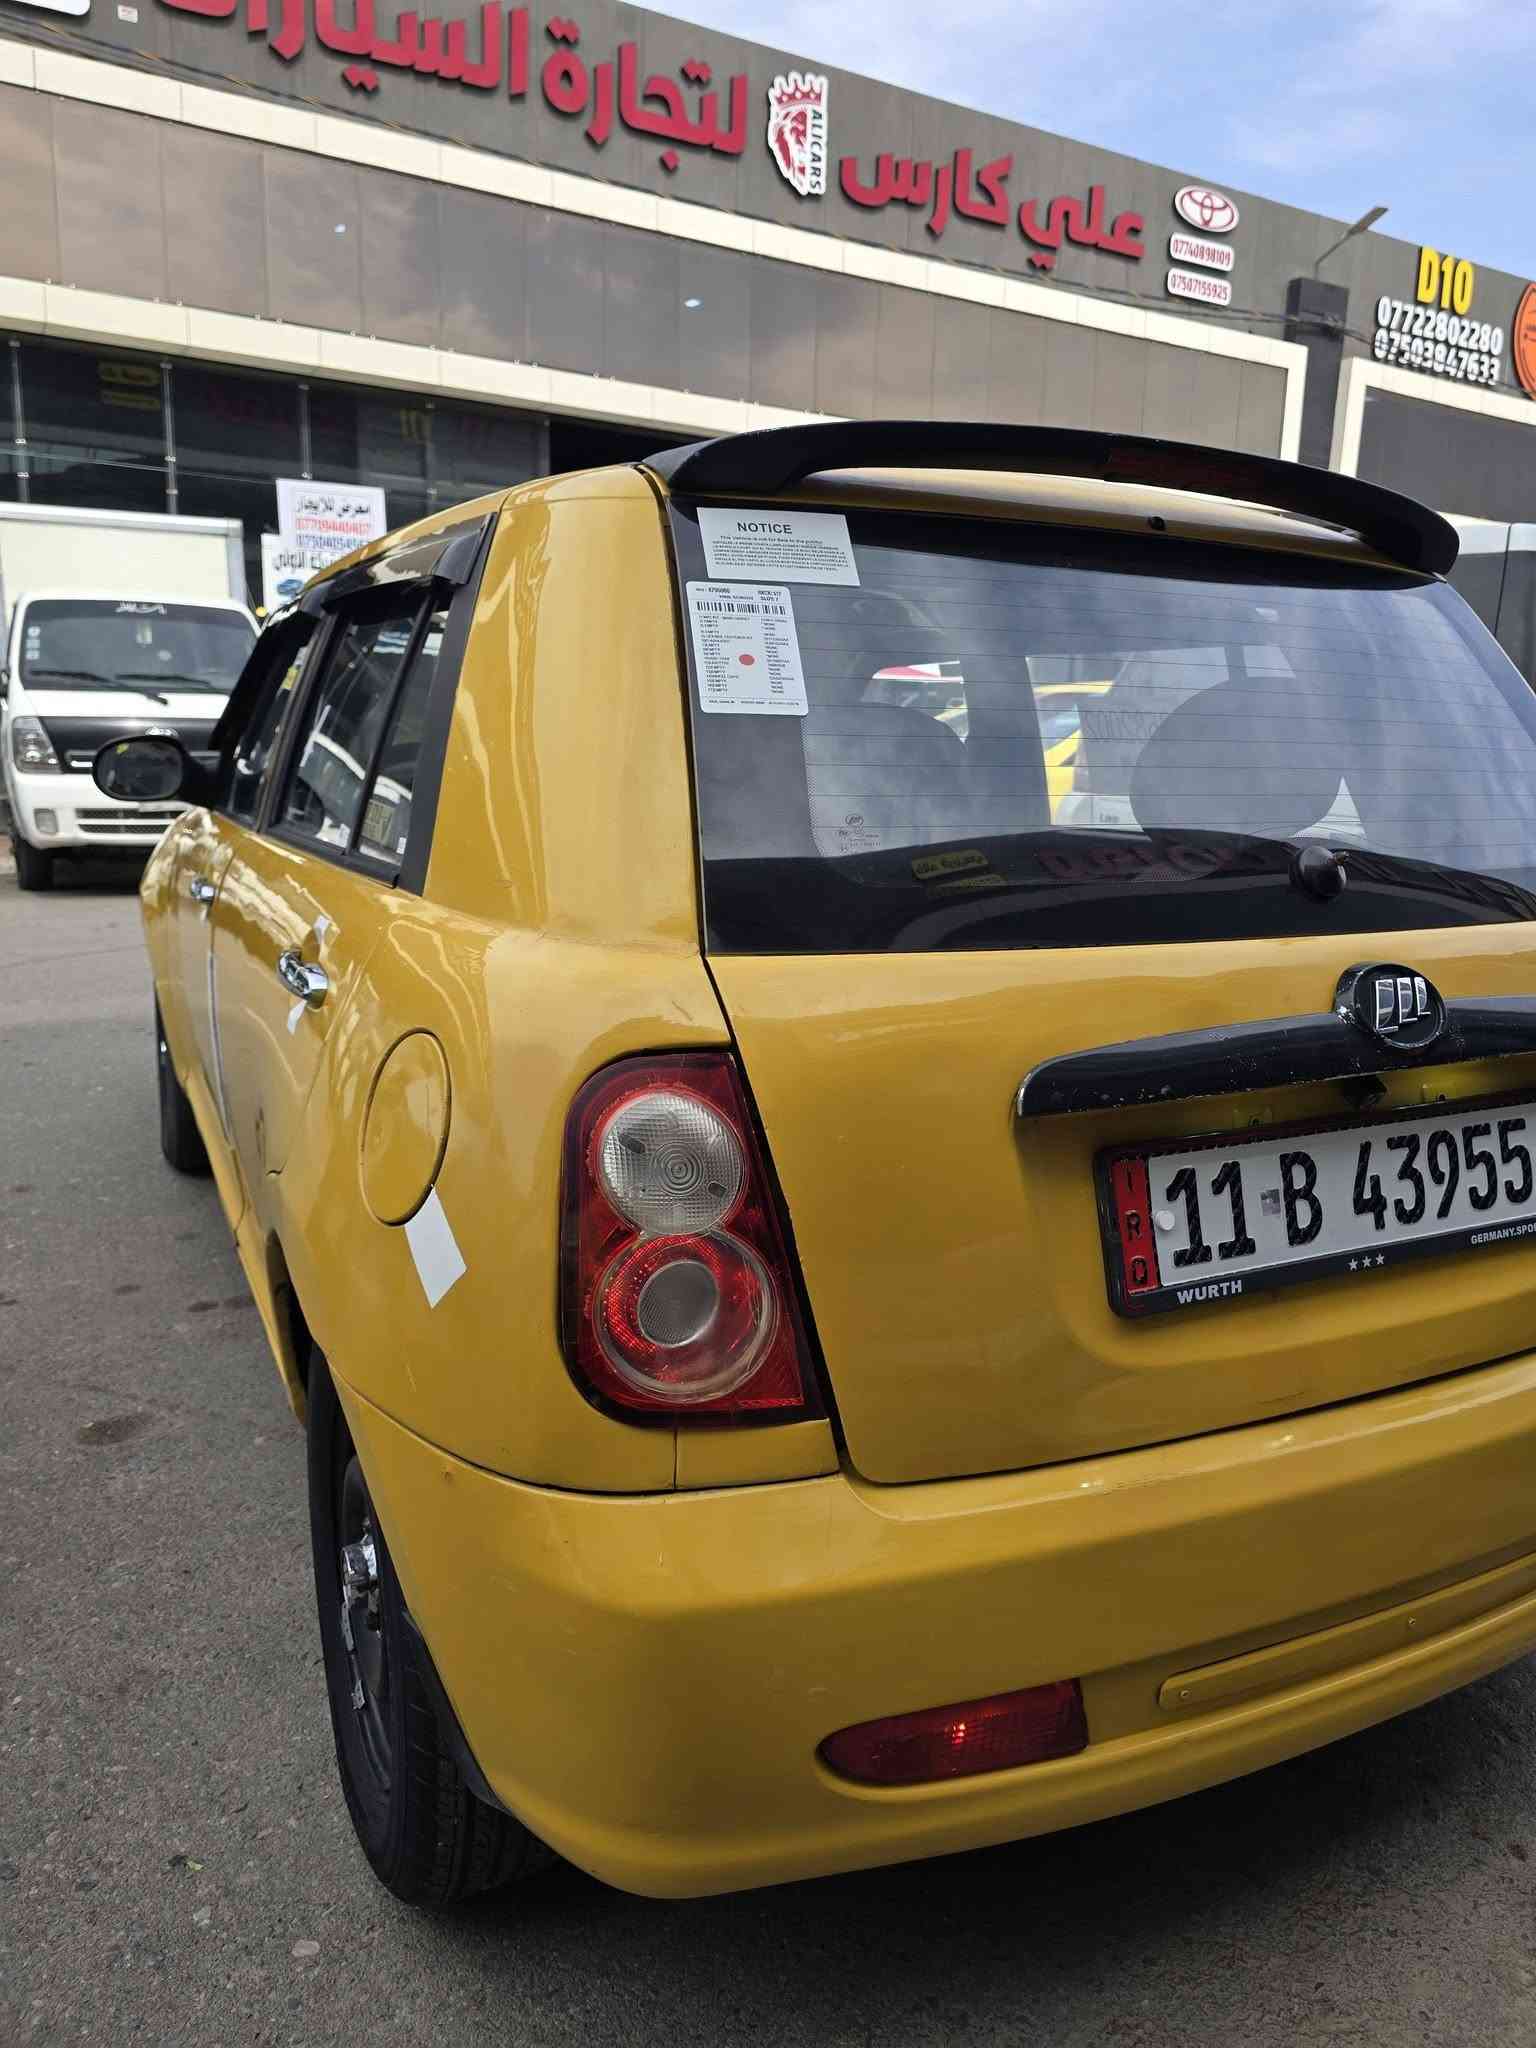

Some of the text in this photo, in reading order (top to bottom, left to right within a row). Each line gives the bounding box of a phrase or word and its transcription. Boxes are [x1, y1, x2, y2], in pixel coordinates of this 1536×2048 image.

[543, 16, 748, 171] لتجارة
[810, 108, 823, 191] ALICARS
[839, 148, 1146, 269] علي كارس
[1417, 245, 1474, 315] D10
[1377, 296, 1504, 356] 07722802280
[737, 522, 793, 534] NOTICE
[1166, 1117, 1533, 1268] 11 B 43955
[1176, 1279, 1243, 1305] WURTH
